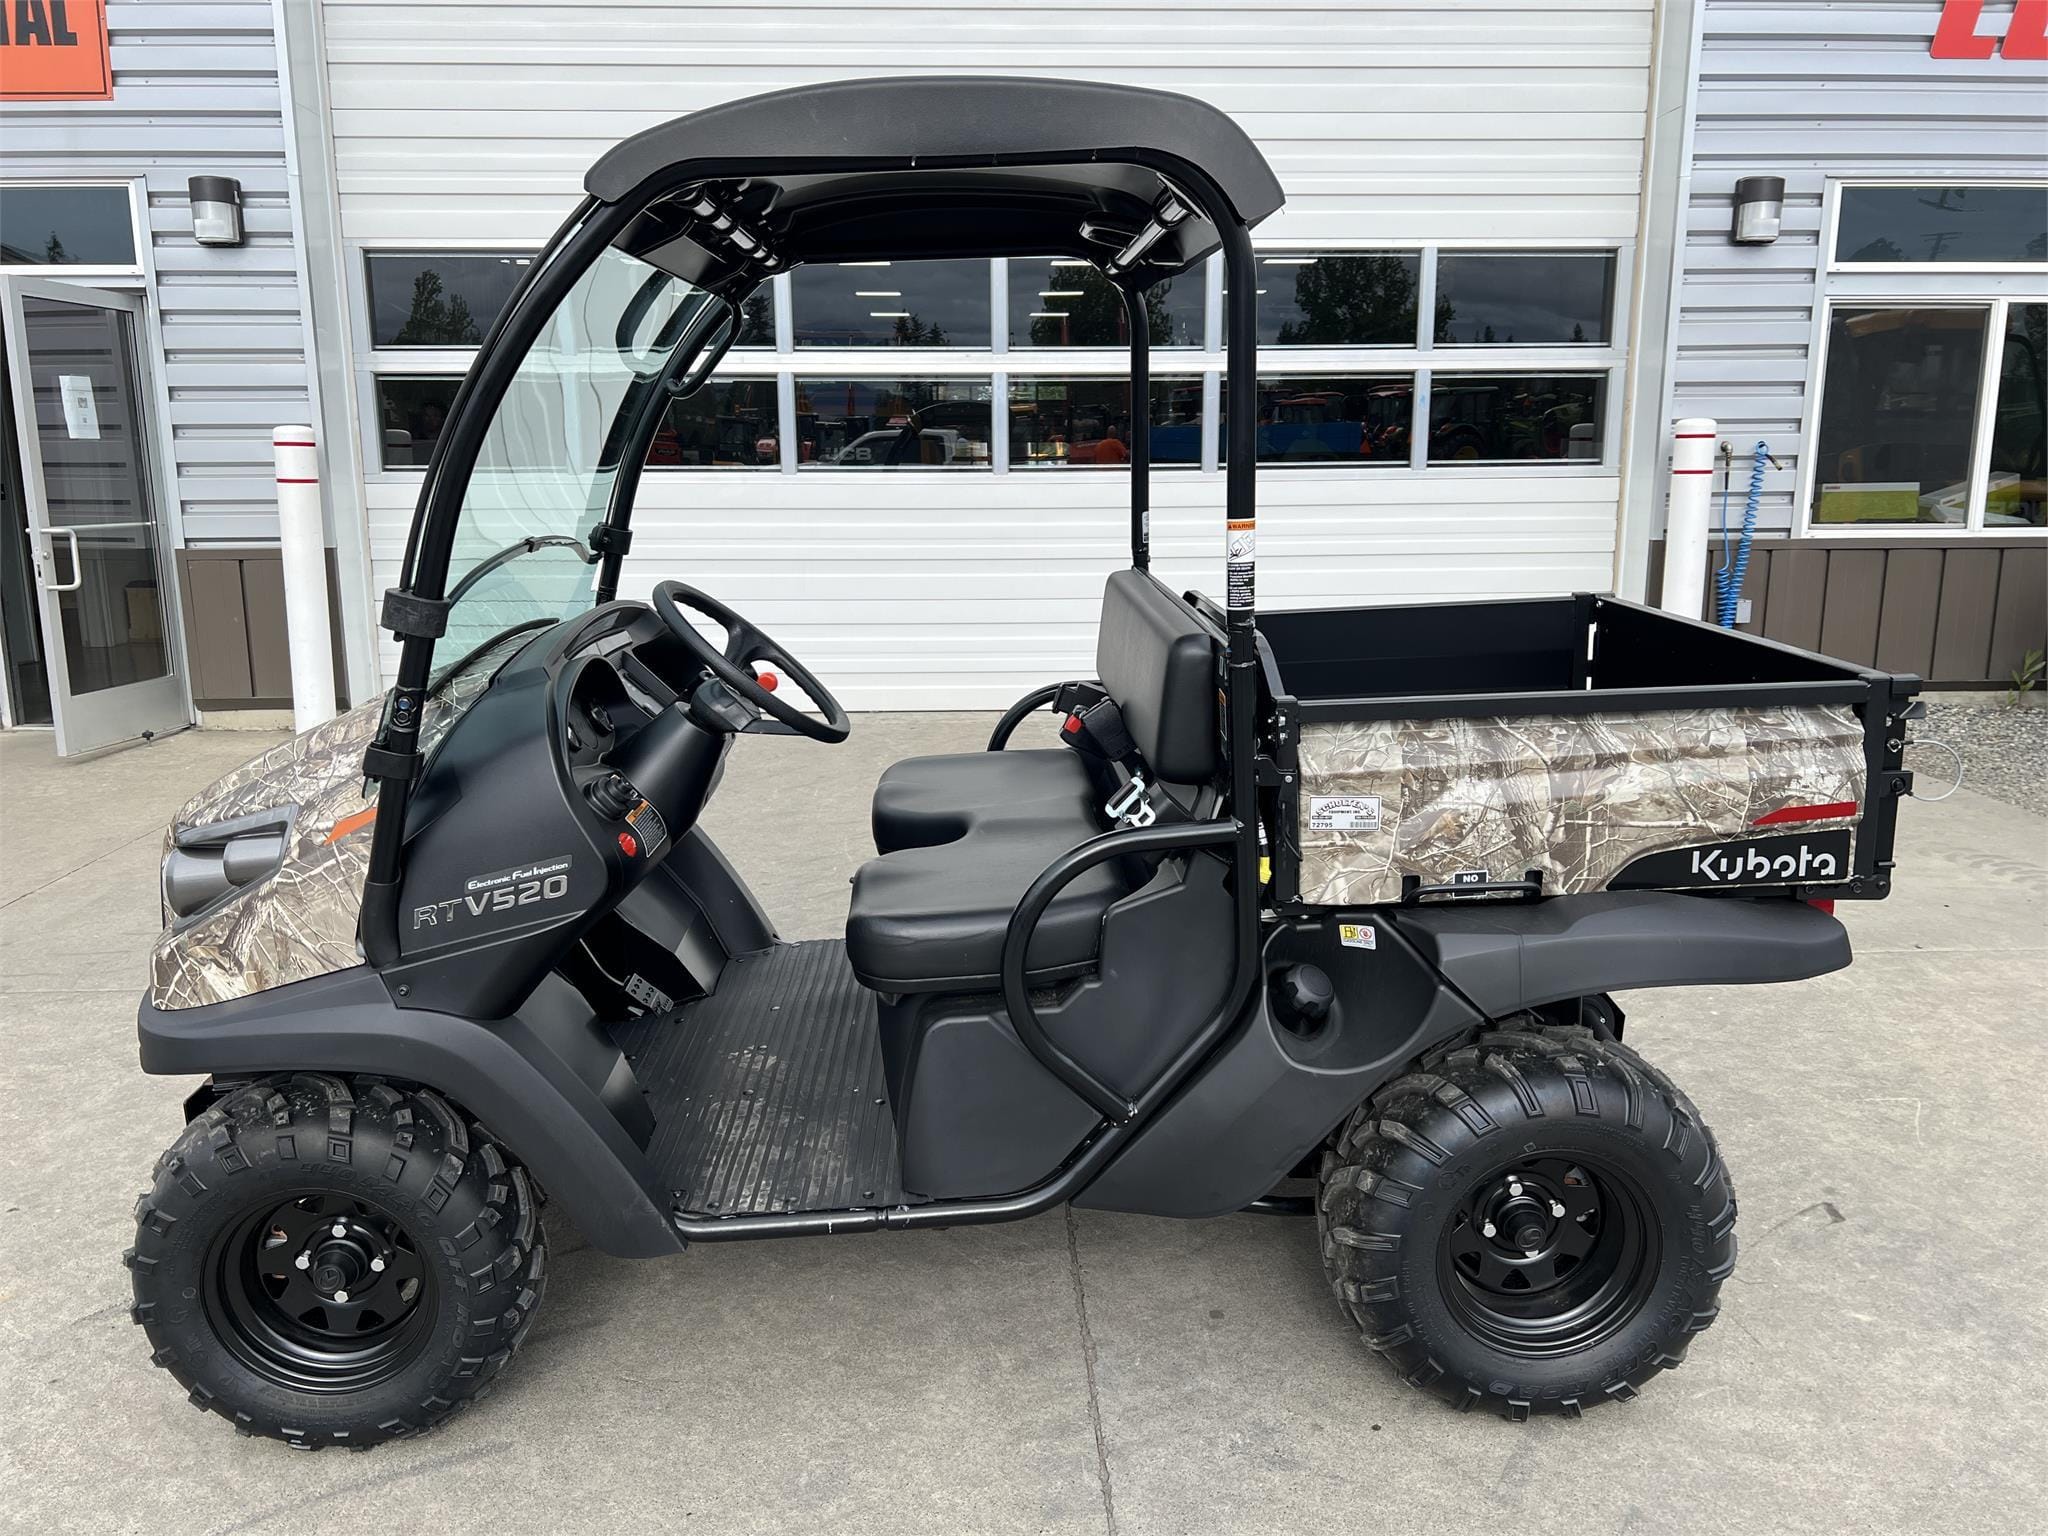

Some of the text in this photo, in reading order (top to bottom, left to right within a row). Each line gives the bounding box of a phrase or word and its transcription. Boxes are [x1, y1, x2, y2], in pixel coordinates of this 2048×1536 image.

[468, 863, 569, 890] Electronic Fuel Injection
[1691, 845, 1837, 881] Kubota
[1462, 874, 1479, 883] NO
[437, 1237, 471, 1297] OFF
[1488, 1378, 1591, 1400] ROAD
